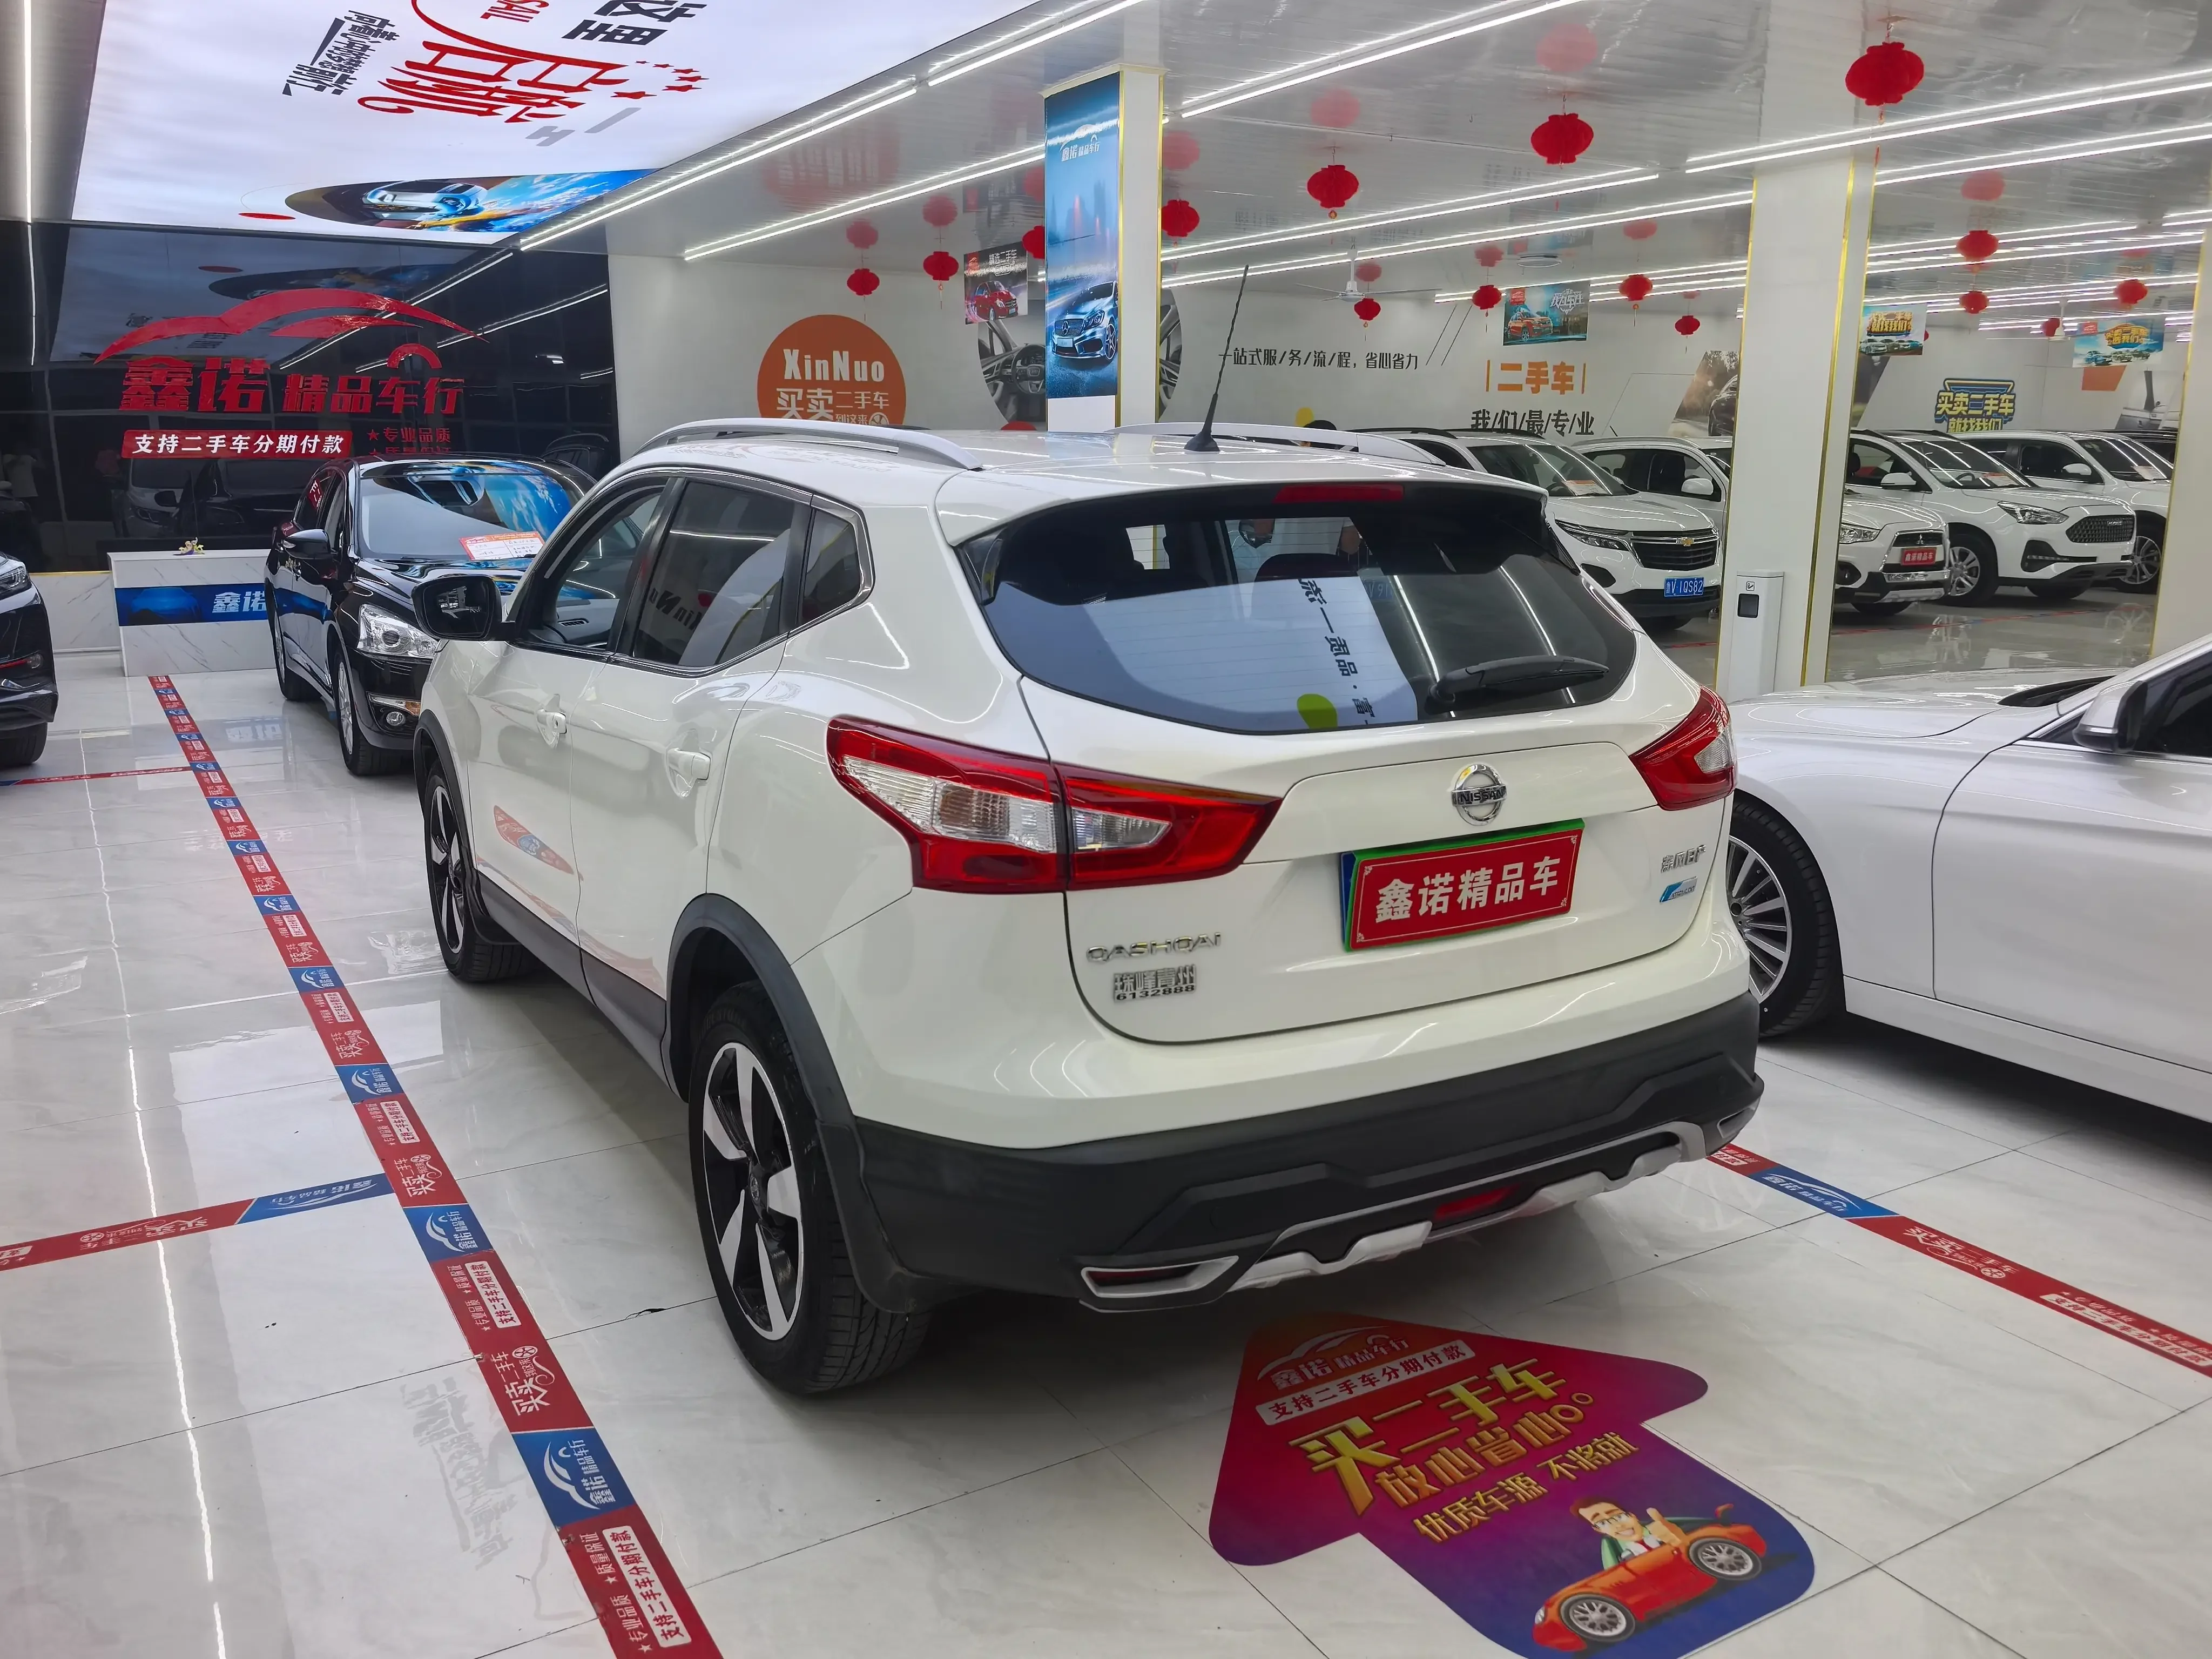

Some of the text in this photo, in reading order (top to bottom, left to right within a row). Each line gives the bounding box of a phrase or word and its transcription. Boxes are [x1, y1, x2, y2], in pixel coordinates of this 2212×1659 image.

[357, 0, 629, 123] 启航
[119, 355, 465, 414] 鑫诺 精品车行
[783, 349, 885, 382] XinNuo
[1498, 361, 1575, 395] 二手车
[1936, 392, 2015, 415] 买卖二手车
[1948, 417, 2002, 433] 就找我们
[132, 434, 344, 454] 支持二手车分期付款
[383, 427, 451, 443] 专业品质
[212, 591, 267, 613] 鑫诺
[1460, 787, 1503, 802] NISSAN
[1375, 856, 1561, 923] 鑫诺精品车
[1086, 932, 1222, 962] QASHQAI
[1116, 984, 1195, 1001] 6132888
[470, 1263, 516, 1325] 支持二手车分期付款
[491, 1351, 550, 1416] 买卖二手车
[1268, 1345, 1466, 1420] 支持二手车分期付款
[1271, 1337, 1410, 1391] 鑫诺 精品车行
[1288, 1358, 1567, 1516] 买二手车
[567, 1439, 616, 1505] 鑫诺 精品车行
[1413, 1431, 1640, 1543] 优质车源 不将就
[579, 1532, 616, 1575] 质量保证
[610, 1530, 684, 1641] 支持二手车分期付款
[610, 1594, 648, 1642] 专业品质
